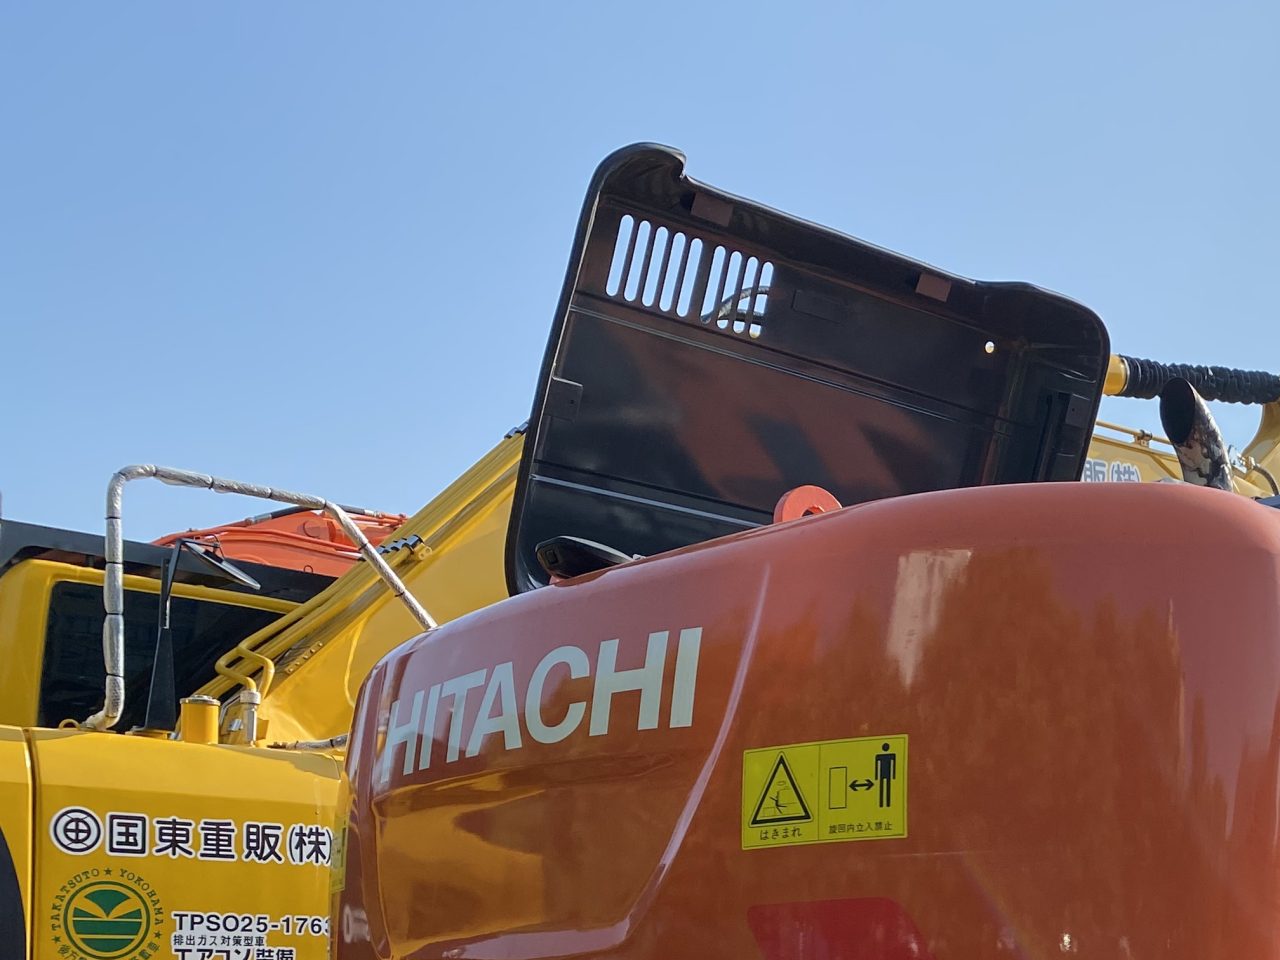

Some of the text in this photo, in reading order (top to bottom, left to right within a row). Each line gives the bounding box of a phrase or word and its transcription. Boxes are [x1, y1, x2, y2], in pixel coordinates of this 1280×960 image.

[380, 627, 703, 783] HITACHI
[109, 814, 332, 865] 国東重販(株)
[119, 868, 163, 926] YOKOHAMA
[173, 935, 265, 947] 排出ガス対策型車
